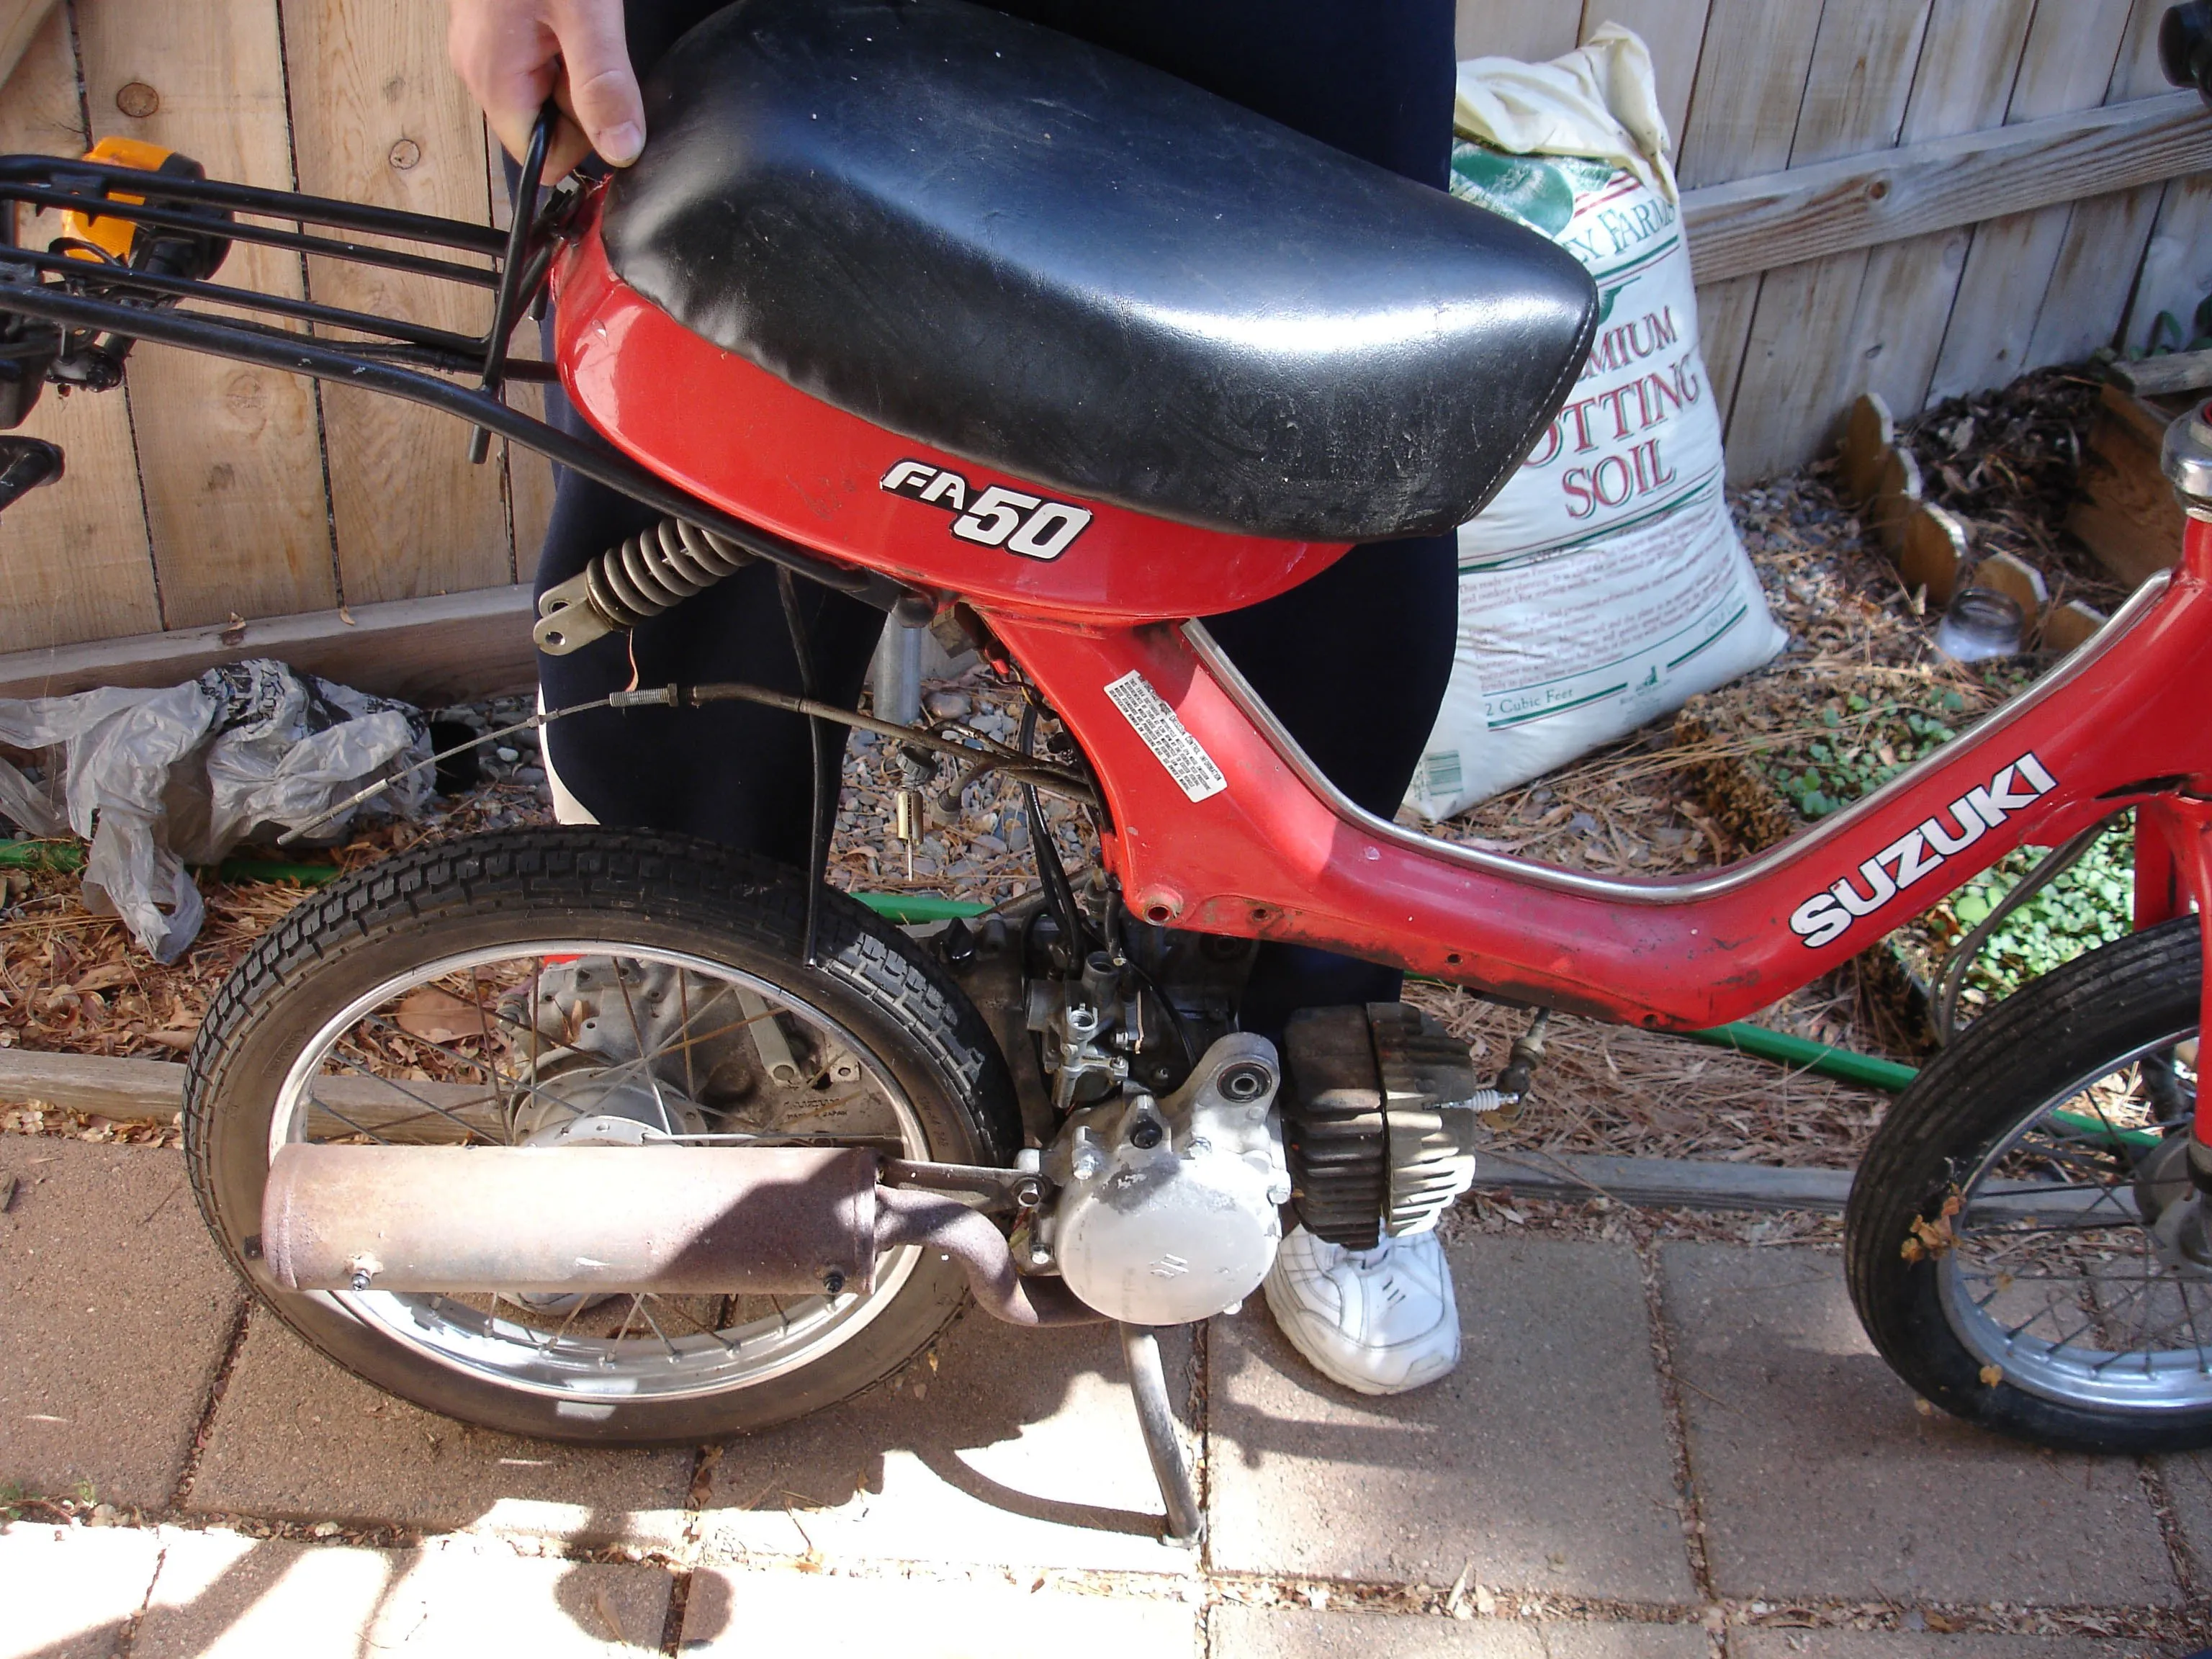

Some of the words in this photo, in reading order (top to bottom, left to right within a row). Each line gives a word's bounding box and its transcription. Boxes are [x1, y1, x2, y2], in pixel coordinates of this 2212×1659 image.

[1562, 438, 1676, 520] SOIL
[1485, 702, 1493, 716] 2
[1500, 693, 1540, 714] Cubic
[1545, 688, 1573, 703] Feet
[1184, 736, 1201, 755] CONTROL
[1199, 755, 1222, 781] INFORMATION
[1789, 750, 2059, 949] SUZUKI
